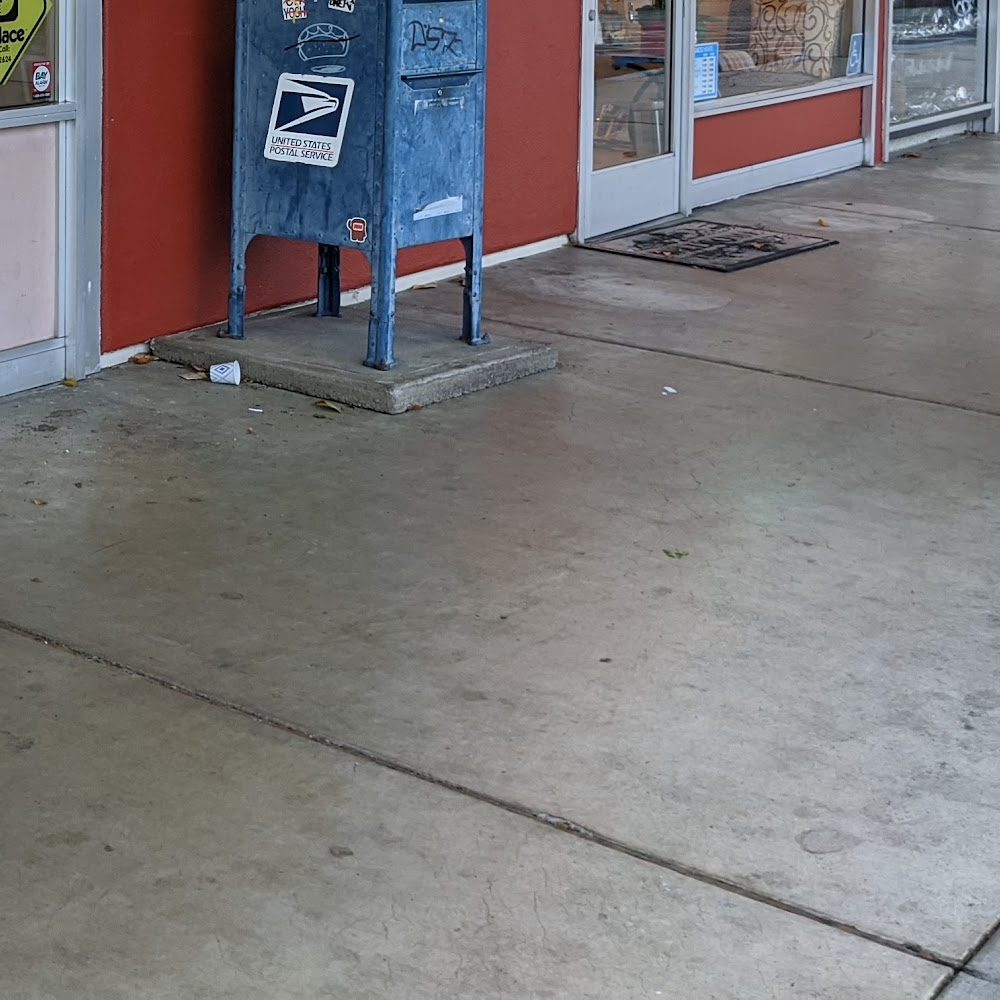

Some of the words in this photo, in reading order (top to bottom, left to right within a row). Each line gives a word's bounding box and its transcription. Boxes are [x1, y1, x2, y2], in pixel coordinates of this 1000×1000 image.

[35, 71, 48, 80] BAY
[271, 136, 302, 147] UNITED
[303, 139, 332, 151] STATES
[269, 146, 299, 157] POSTAL
[300, 150, 334, 161] SERVICE
